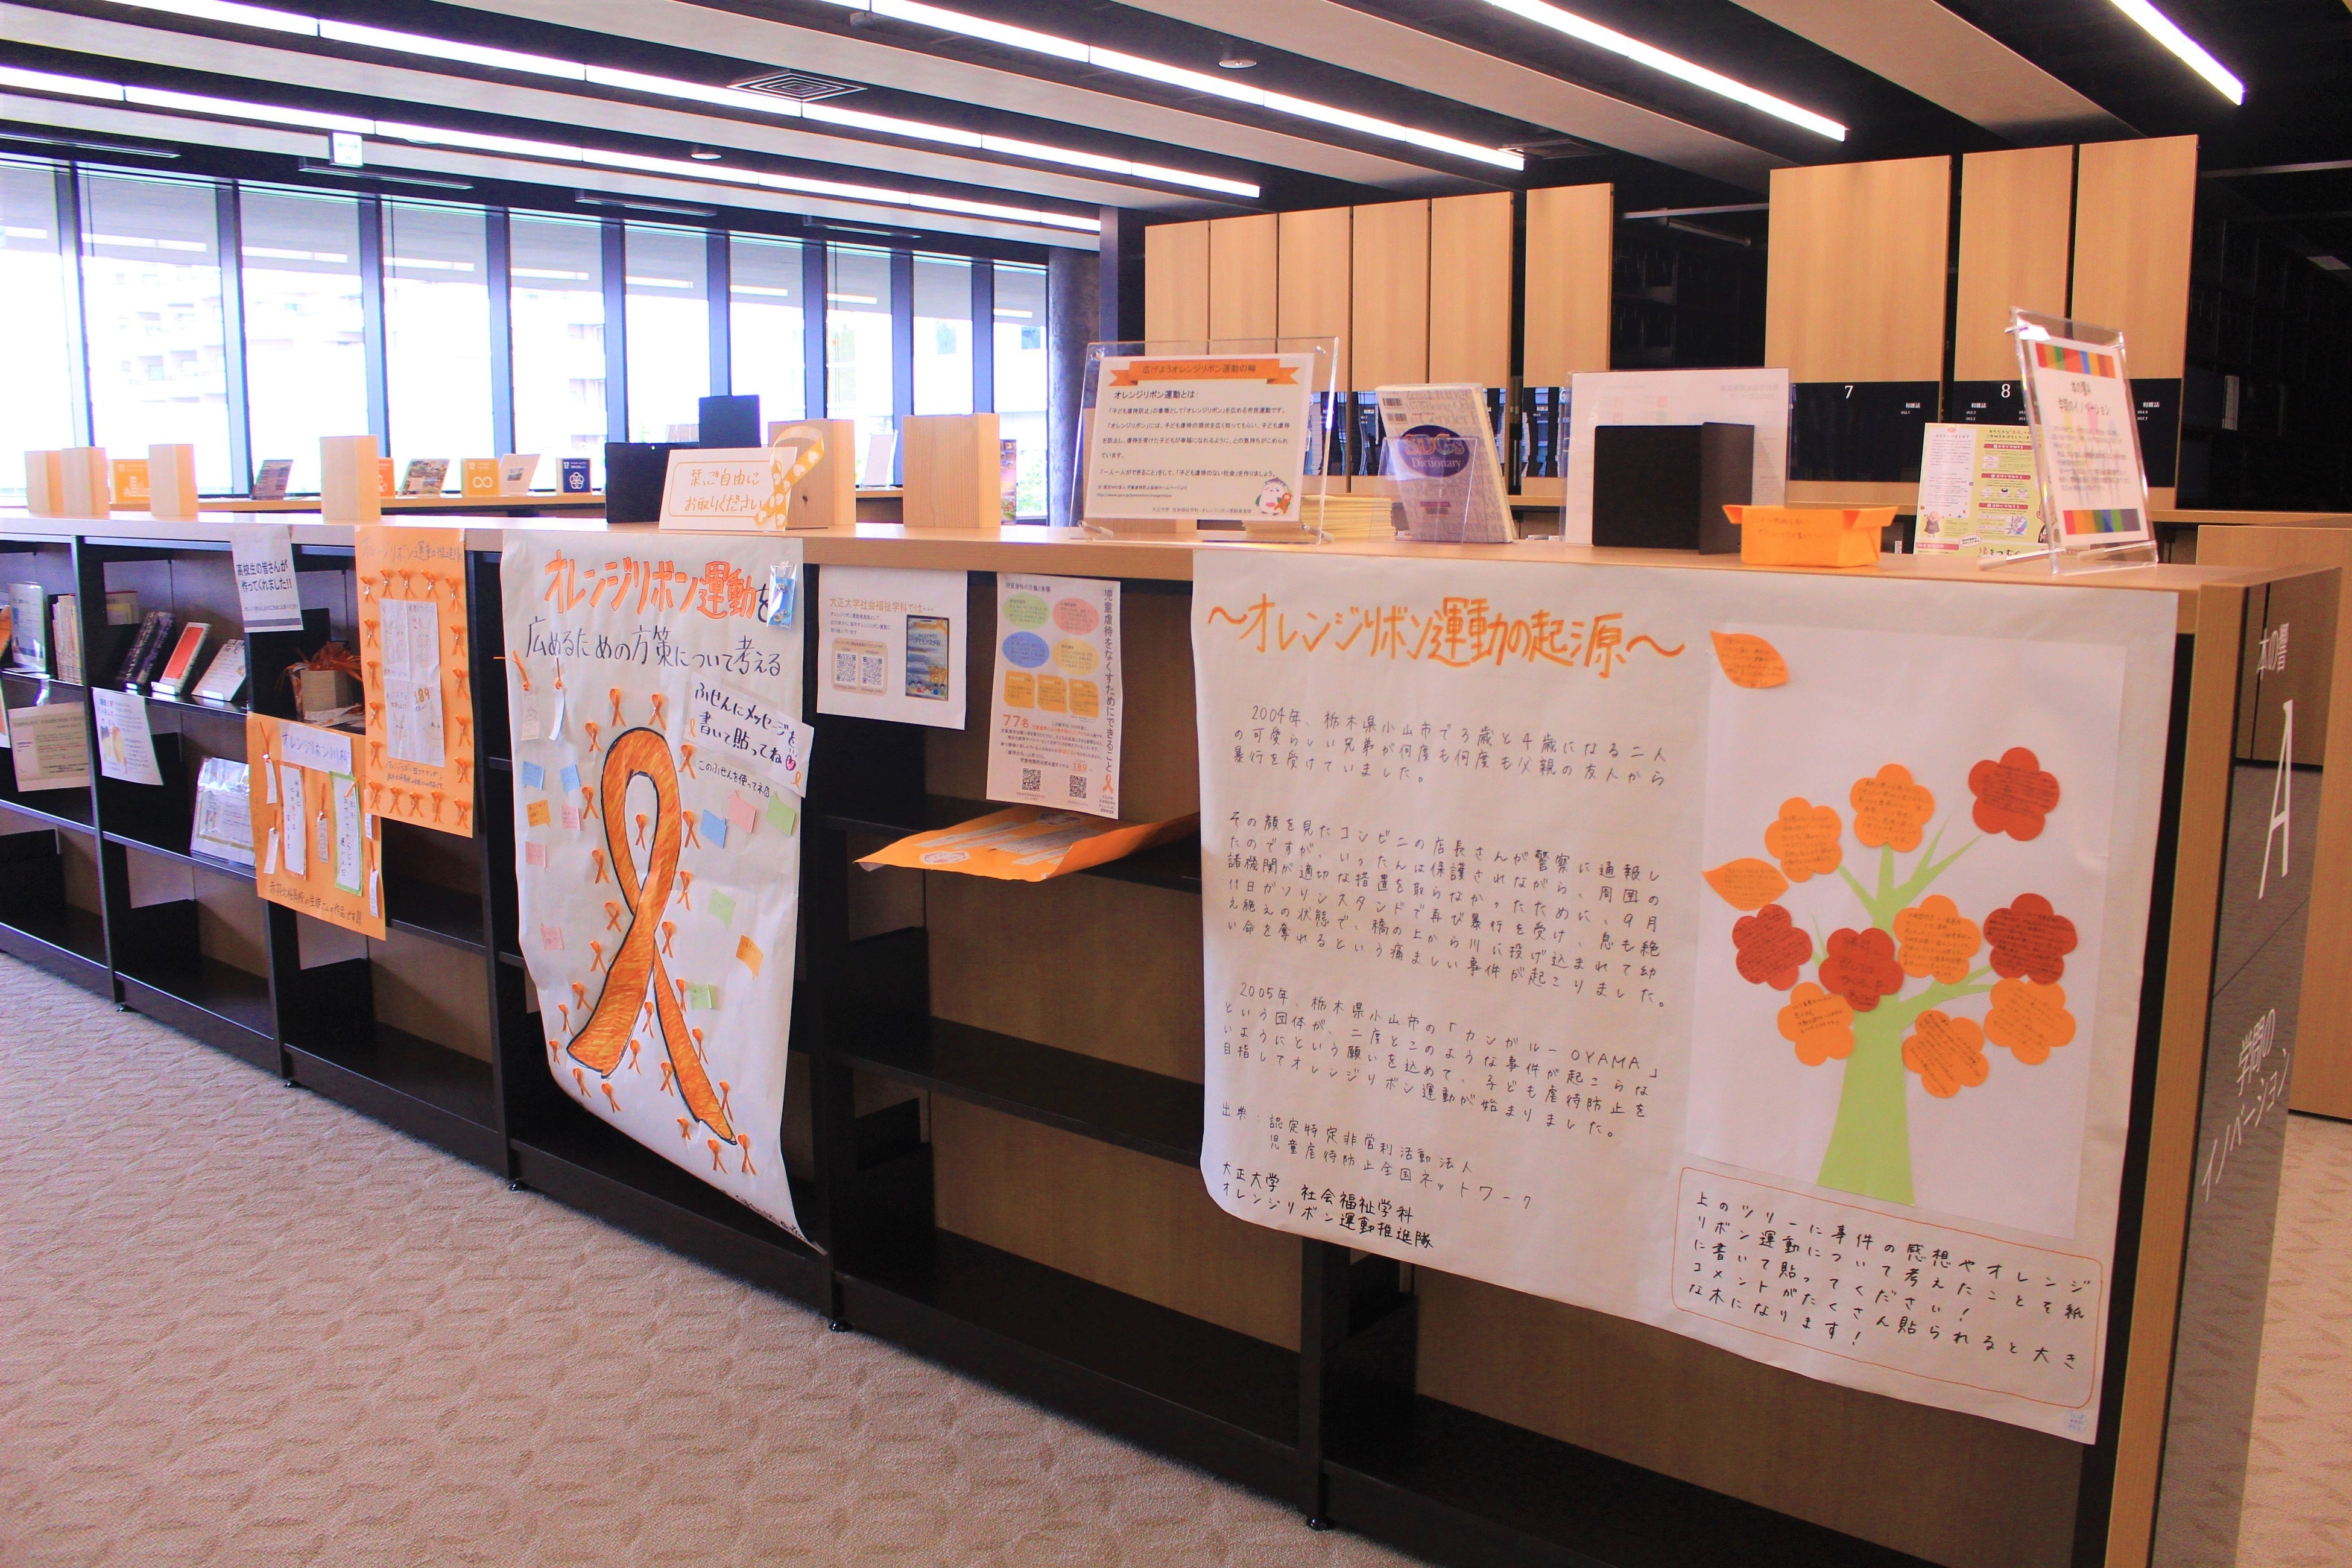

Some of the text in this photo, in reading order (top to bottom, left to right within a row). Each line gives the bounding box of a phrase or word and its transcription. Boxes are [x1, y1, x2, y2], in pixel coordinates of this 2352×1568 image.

[1845, 385, 1854, 399] 7
[2001, 384, 2011, 398] 8
[1405, 434, 1465, 455] SDGs
[1411, 457, 1461, 470] Dictionary
[684, 495, 763, 512] お取りください
[236, 560, 288, 575] 高校生の皆さんが
[525, 615, 782, 677] 広めるための方策について考える
[414, 686, 431, 704] 189
[1103, 589, 1116, 774] 児童虐待をなくすためにできること
[694, 682, 798, 747] ふせんにメッセージを
[699, 711, 783, 765] 書いて貼ってね
[1002, 714, 1029, 729] 77名
[1072, 762, 1088, 772] 189
[2257, 698, 2293, 900] A
[2202, 1047, 2290, 1203] イノベーション
[1223, 1162, 1414, 1222] 大正大学 社会福祉学科
[1269, 1134, 1532, 1209] 児童虐待防止全国ネットワーク
[1223, 1181, 1435, 1250] オレンジリボン運動推進隊
[1696, 1191, 2091, 1294] 上のツリーに事件の感想やオレンジ
[1697, 1213, 2085, 1321] リボン運動について考えたことを紙
[1693, 1261, 2076, 1370] コメントがたくさん貼られると大き
